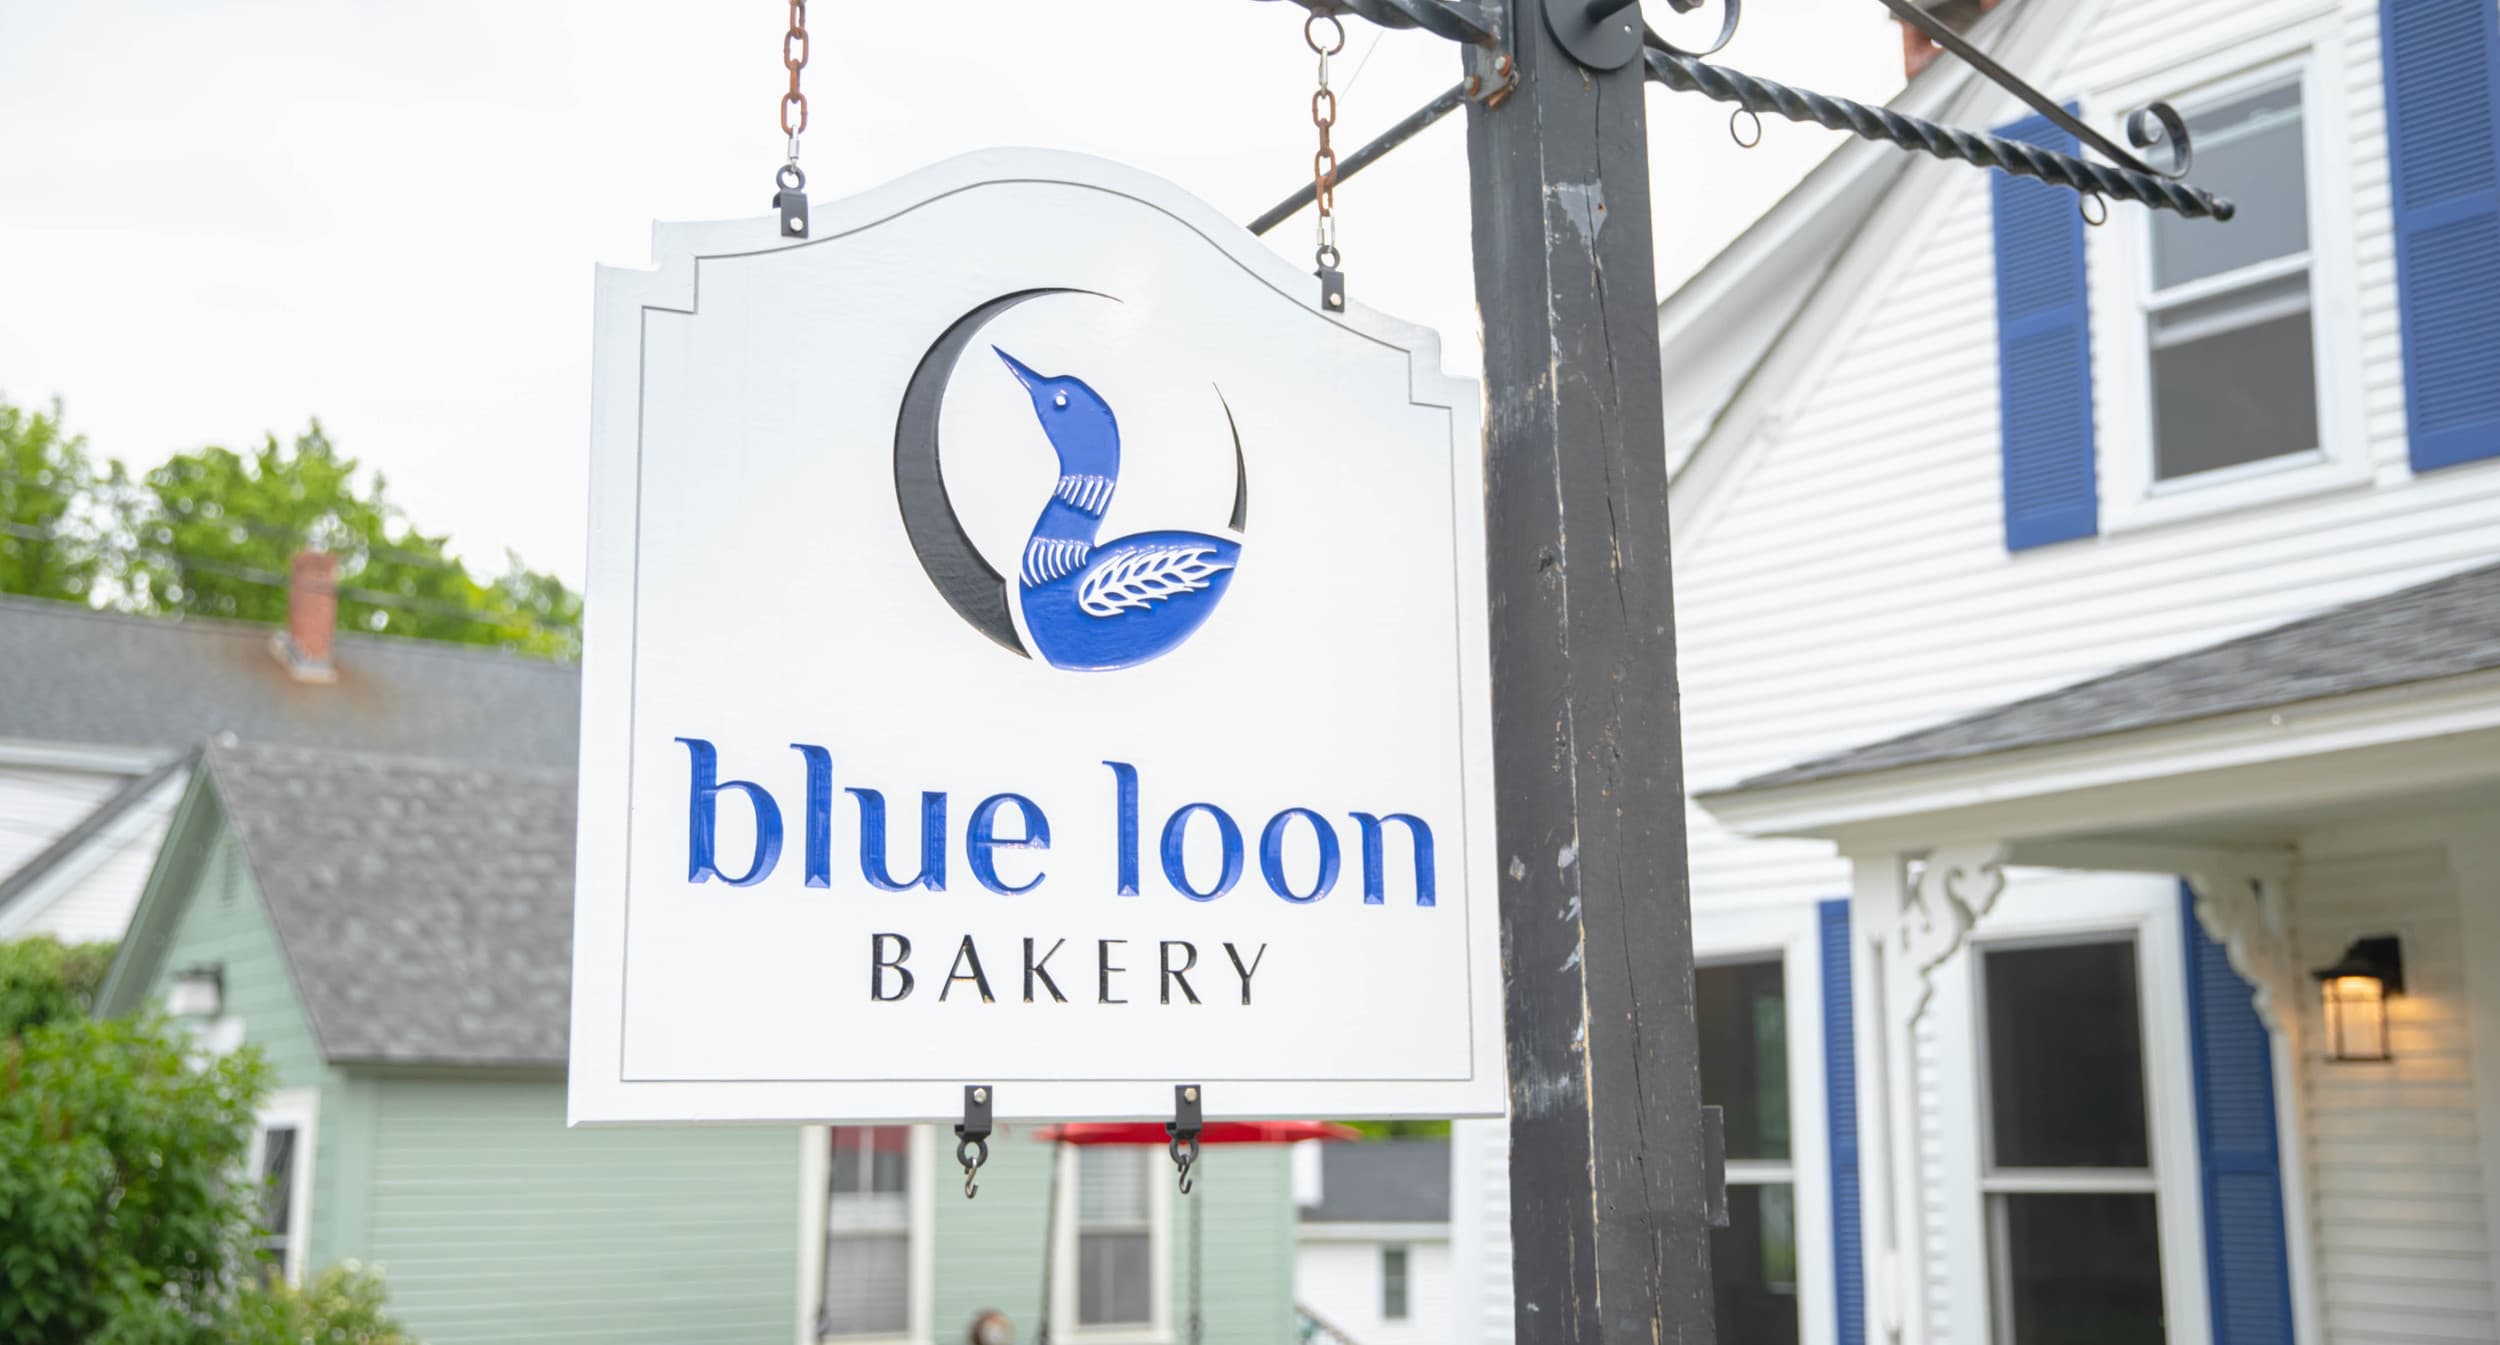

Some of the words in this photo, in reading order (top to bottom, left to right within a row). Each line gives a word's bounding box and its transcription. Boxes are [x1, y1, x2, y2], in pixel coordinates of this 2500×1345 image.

[675, 737, 1050, 894] blue
[1102, 761, 1435, 906] loon
[872, 934, 1266, 1005] BAKERY
